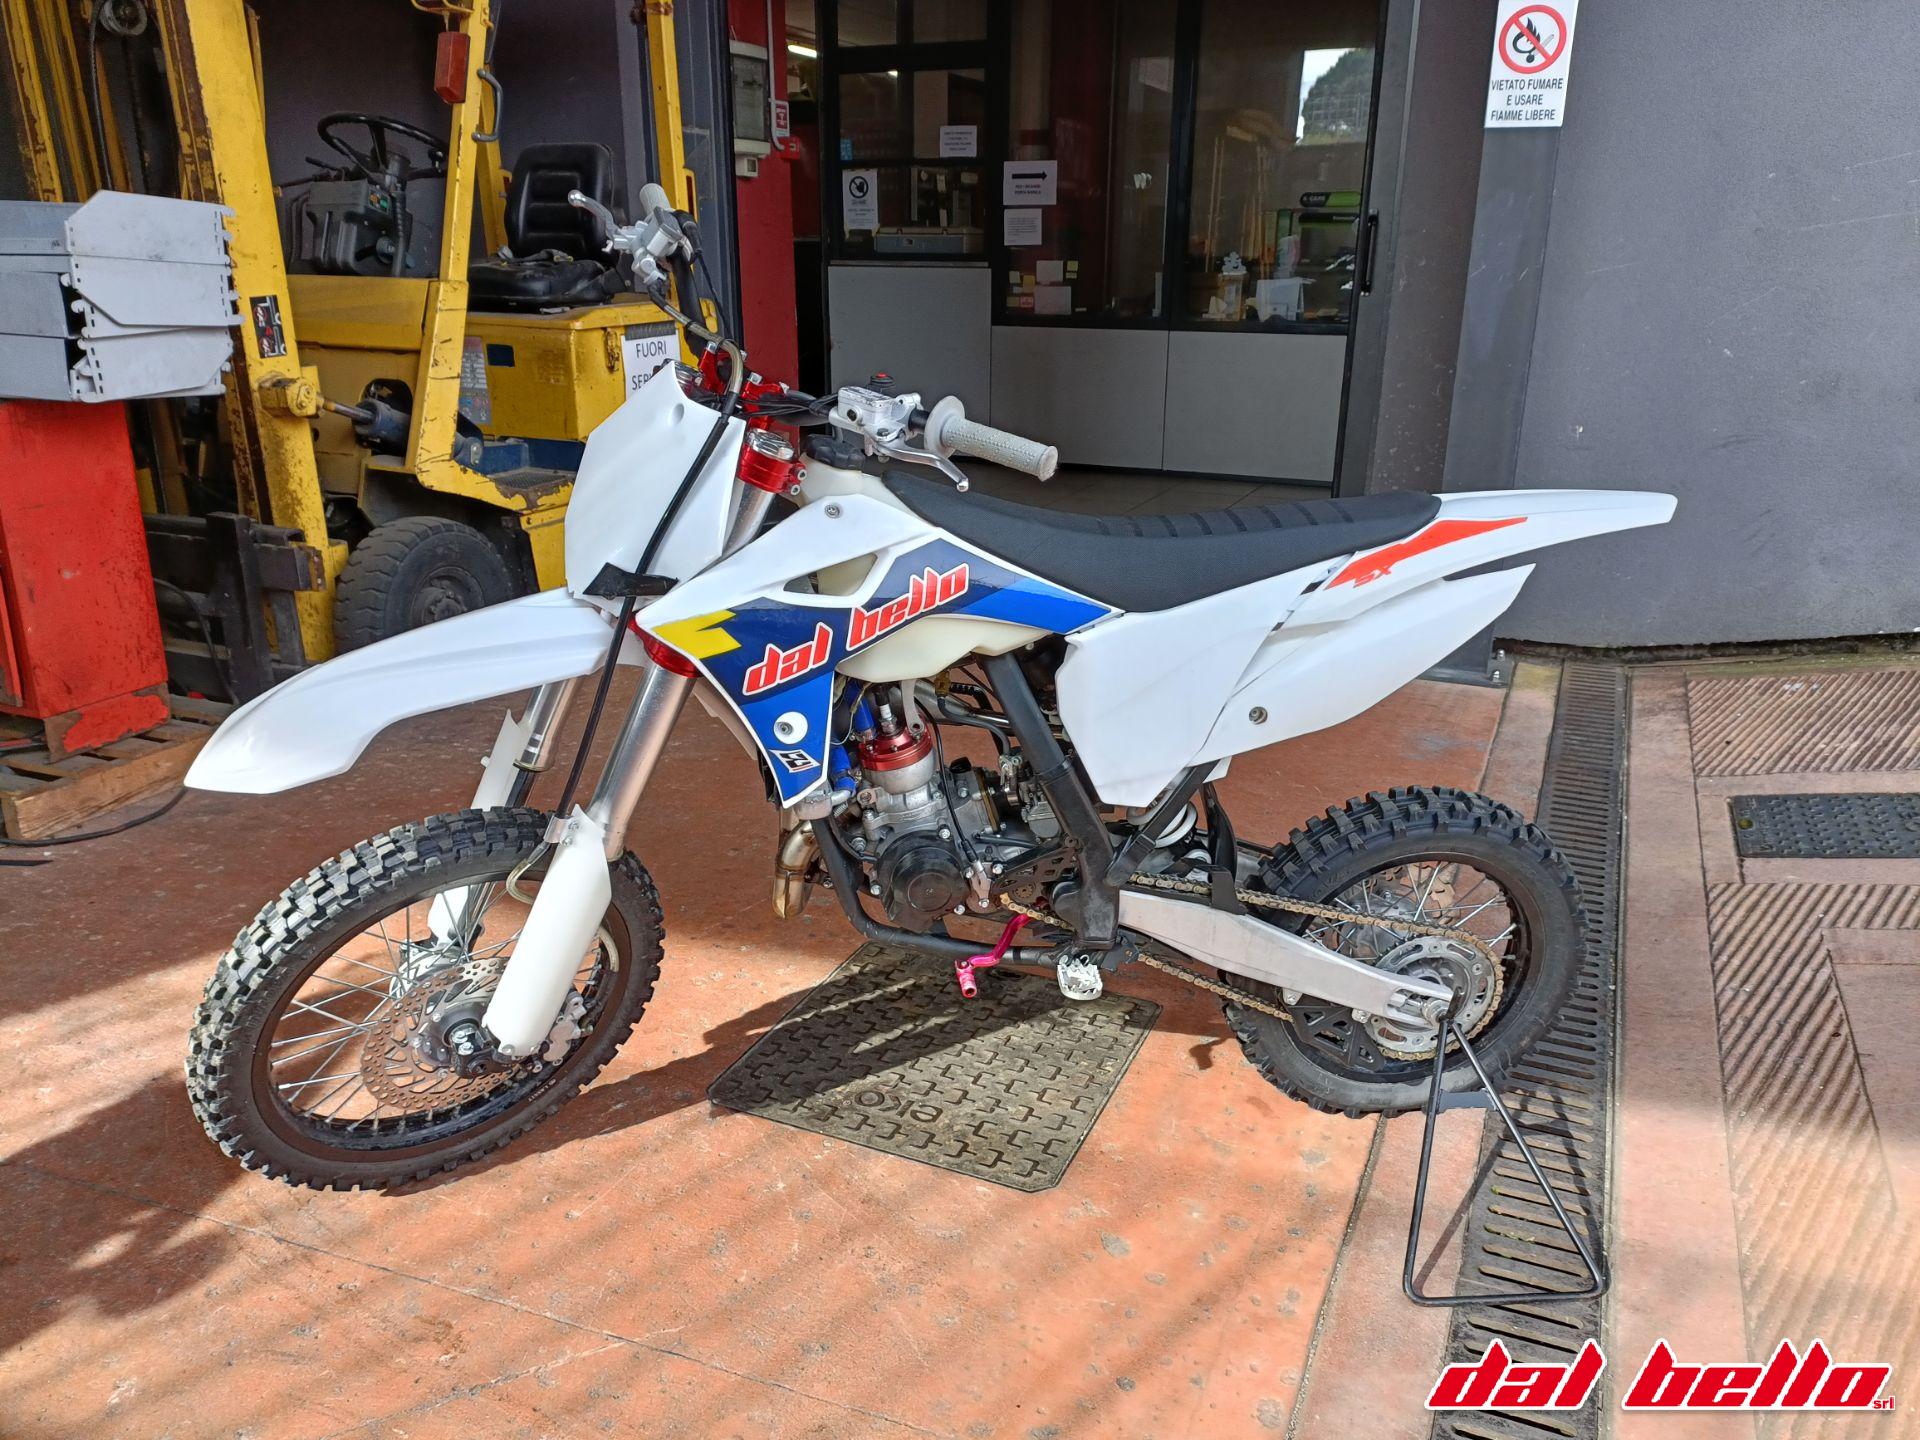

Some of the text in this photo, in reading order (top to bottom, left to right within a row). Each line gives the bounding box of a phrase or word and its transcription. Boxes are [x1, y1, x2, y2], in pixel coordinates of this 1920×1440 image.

[1491, 79, 1563, 90] VIETATO FUMARE
[1506, 95, 1543, 105] E USARE
[1491, 110, 1555, 120] FIAMME LIBERE
[636, 340, 667, 358] FUORI
[632, 373, 652, 390] SER
[743, 563, 969, 695] dal bello
